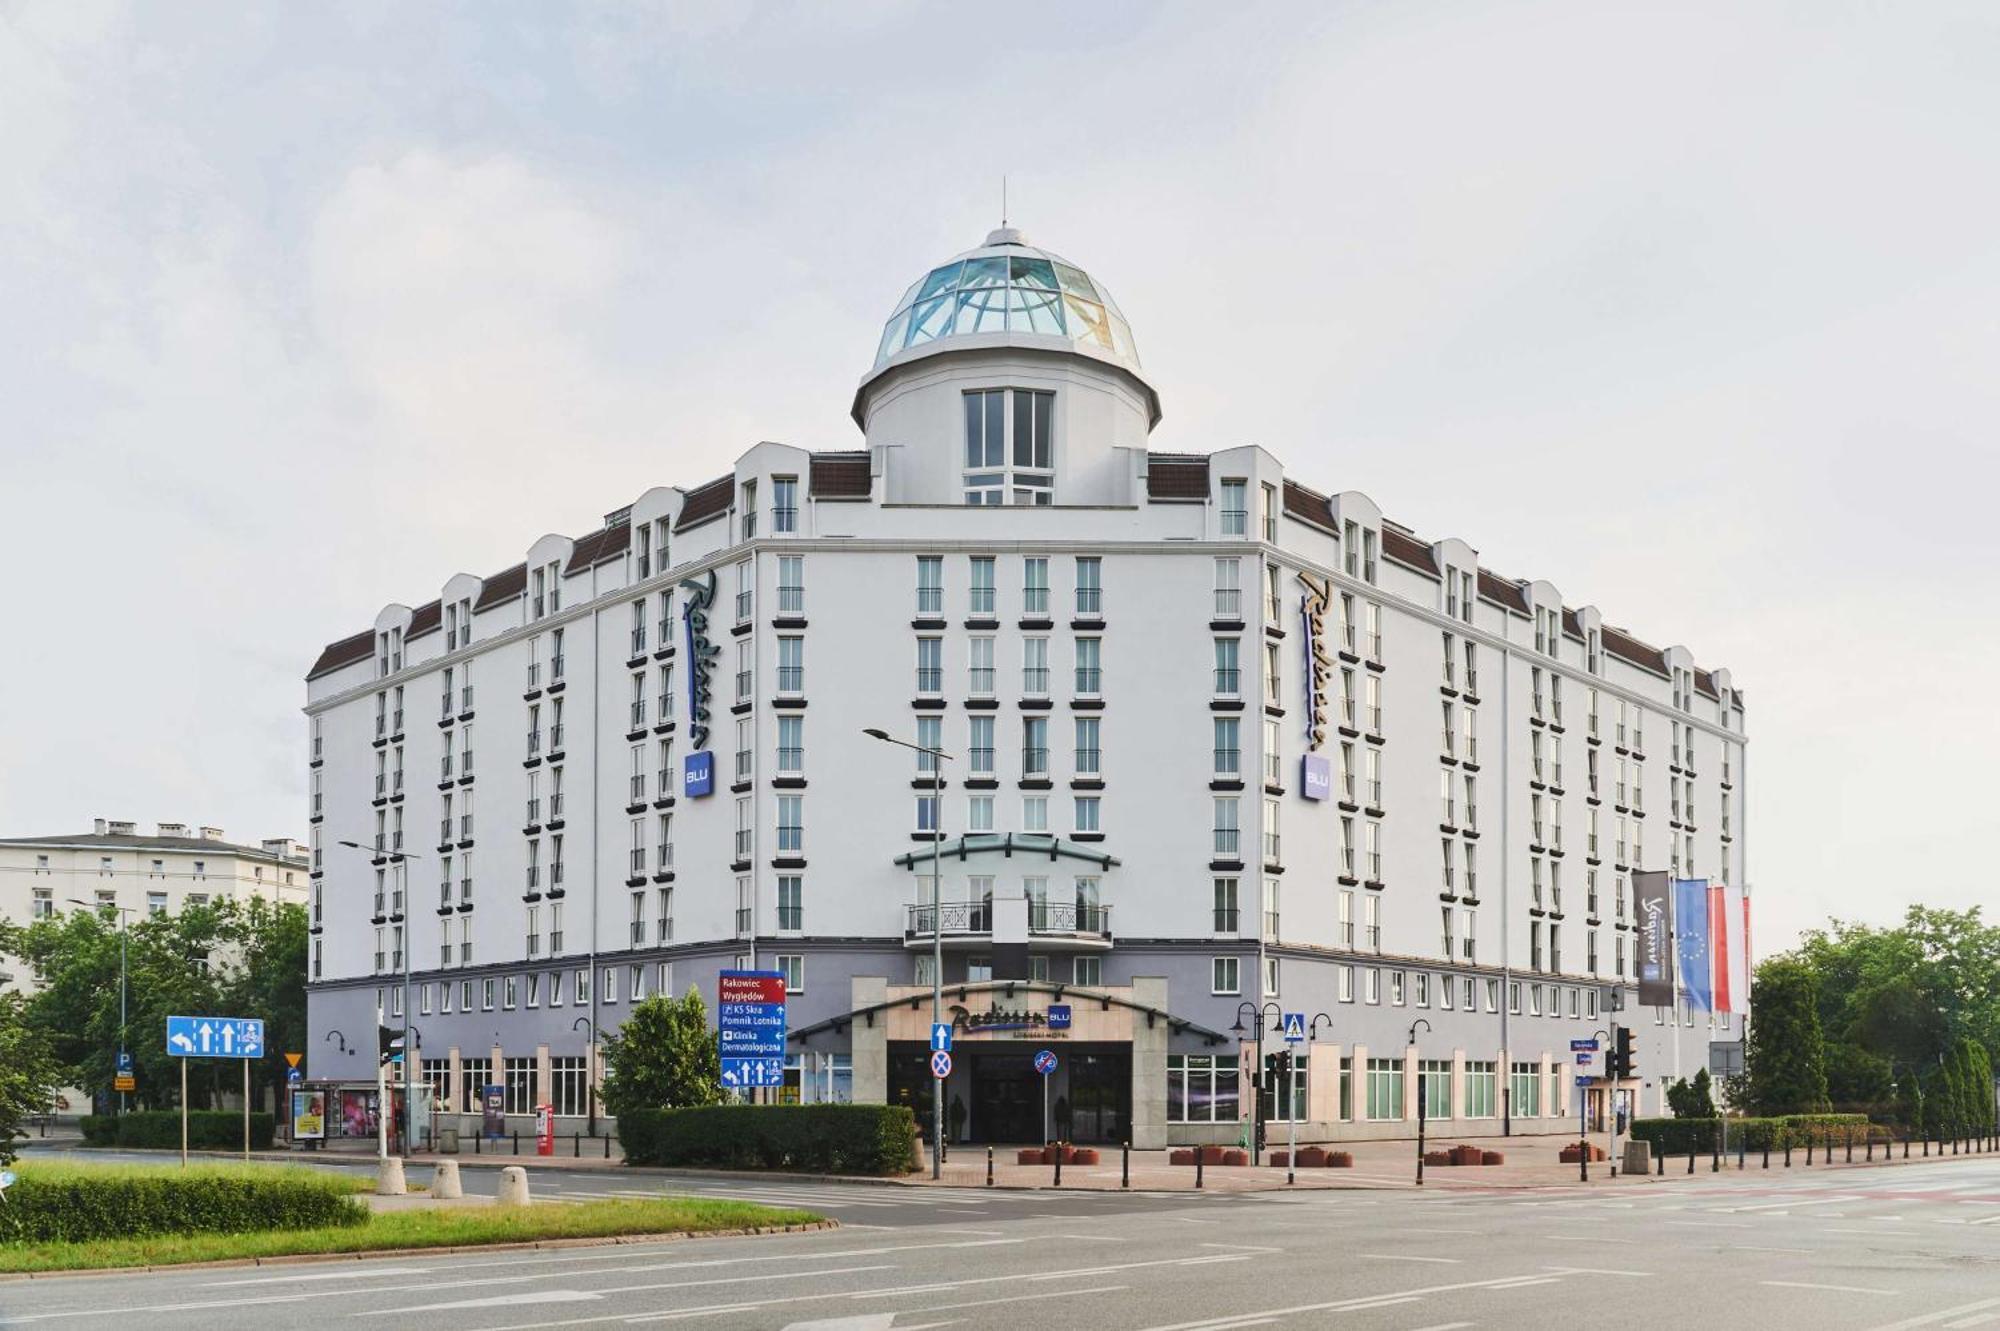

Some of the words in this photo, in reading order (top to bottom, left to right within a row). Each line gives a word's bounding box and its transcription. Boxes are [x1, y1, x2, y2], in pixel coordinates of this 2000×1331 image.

[679, 569, 721, 750] Radisson
[1298, 572, 1337, 751] Radisson
[686, 768, 708, 783] BLU
[1307, 771, 1328, 788] BLU
[723, 978, 760, 987] Rakowiec
[723, 991, 764, 1002] Wyględów
[734, 1005, 743, 1014] KS
[746, 1005, 762, 1014] Skra
[723, 1016, 752, 1024] Pomnik
[753, 1016, 781, 1024] Lotnika
[949, 1000, 1046, 1037] Radisson
[733, 1031, 757, 1039] Klinika
[722, 1043, 781, 1053] Dermatologiczna
[120, 1054, 130, 1066] P
